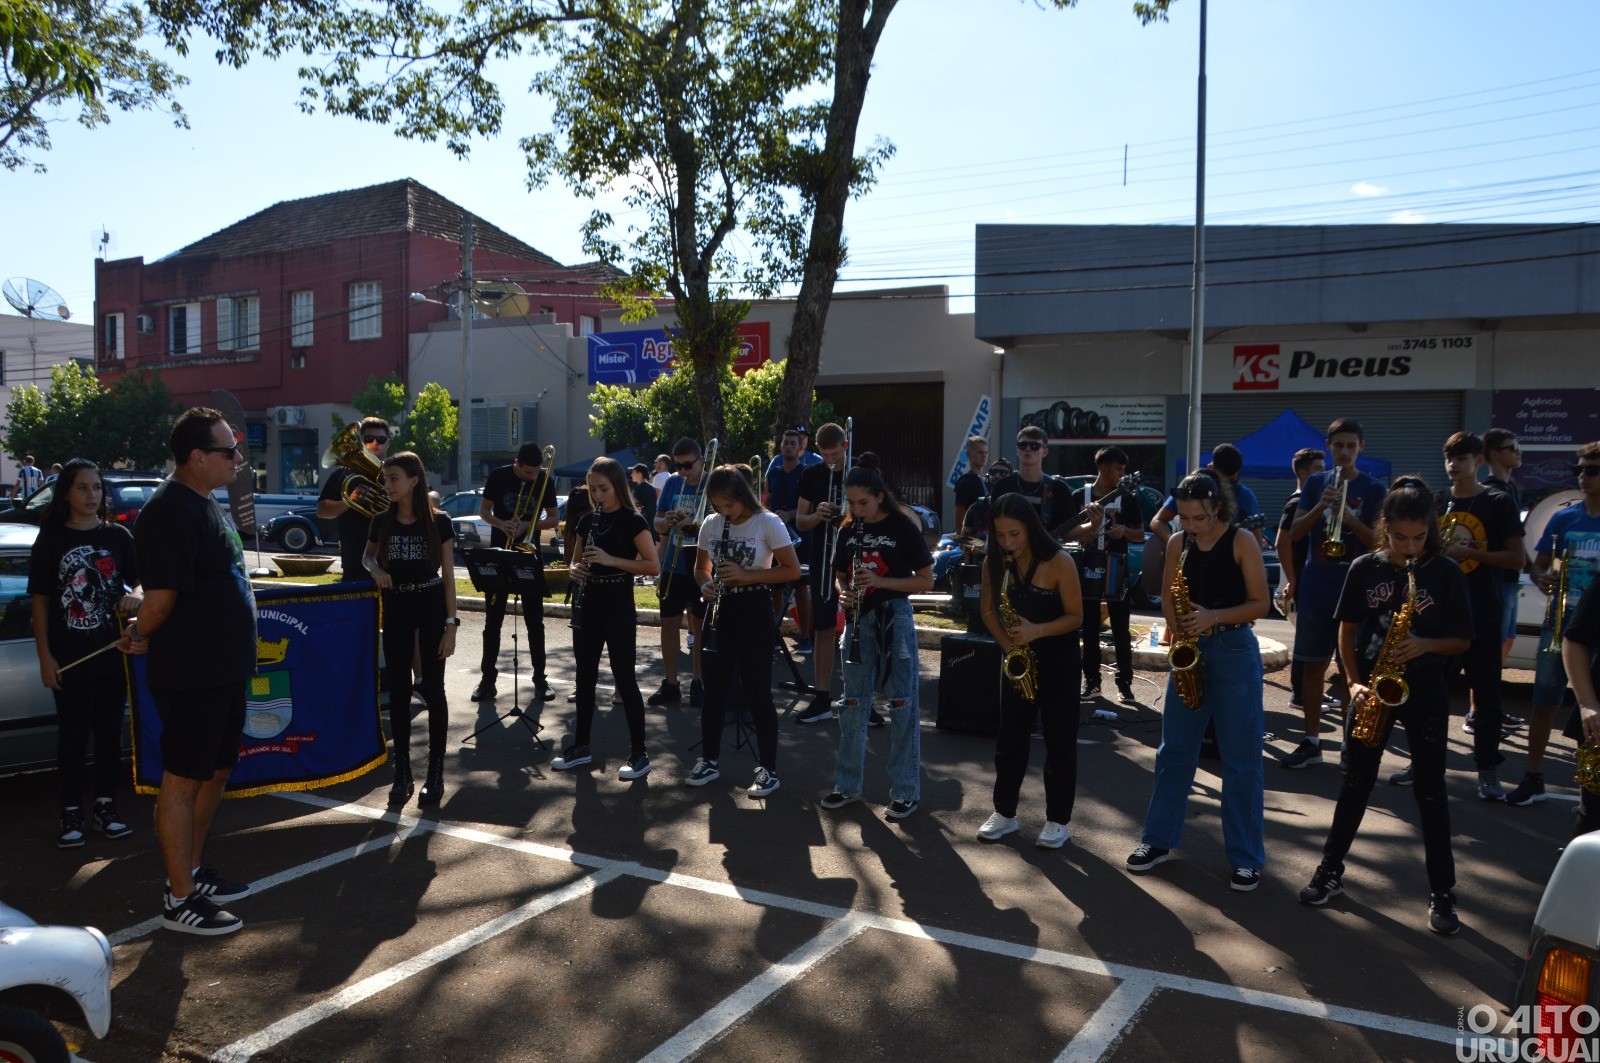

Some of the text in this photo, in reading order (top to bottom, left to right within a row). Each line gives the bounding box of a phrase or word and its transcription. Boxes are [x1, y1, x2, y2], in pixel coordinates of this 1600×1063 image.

[1402, 338, 1437, 350] 3745
[1441, 336, 1473, 349] 1103
[598, 354, 627, 364] Mister
[1233, 350, 1412, 383] KS Pneus
[1522, 397, 1562, 407] Agência
[1531, 410, 1568, 418] Turismo
[1524, 424, 1558, 433] Loja de
[1517, 433, 1573, 442] onveniência
[248, 746, 270, 756] GRANDE
